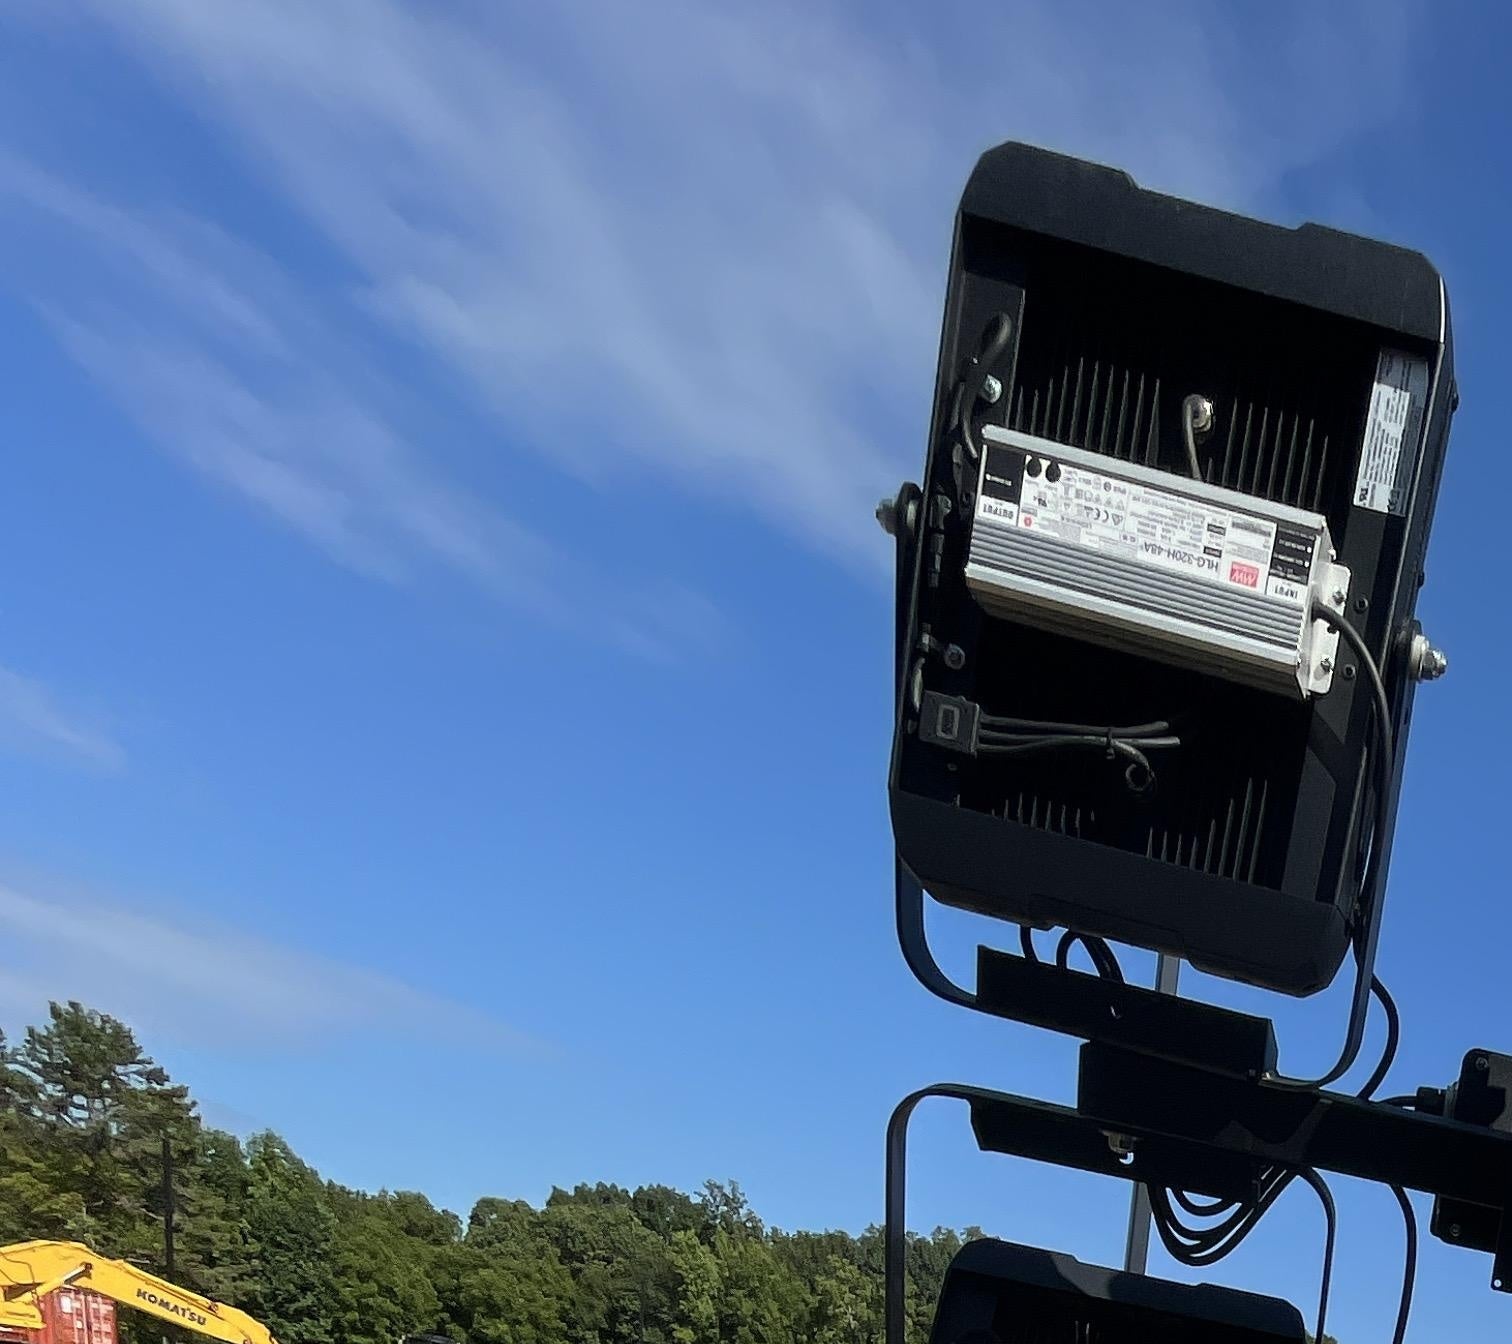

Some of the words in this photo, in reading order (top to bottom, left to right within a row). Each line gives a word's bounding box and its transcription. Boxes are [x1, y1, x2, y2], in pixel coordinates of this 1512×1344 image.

[982, 502, 1014, 519] OUTPUT
[1273, 584, 1298, 599] INPUT
[137, 1287, 207, 1326] KOMATSU
